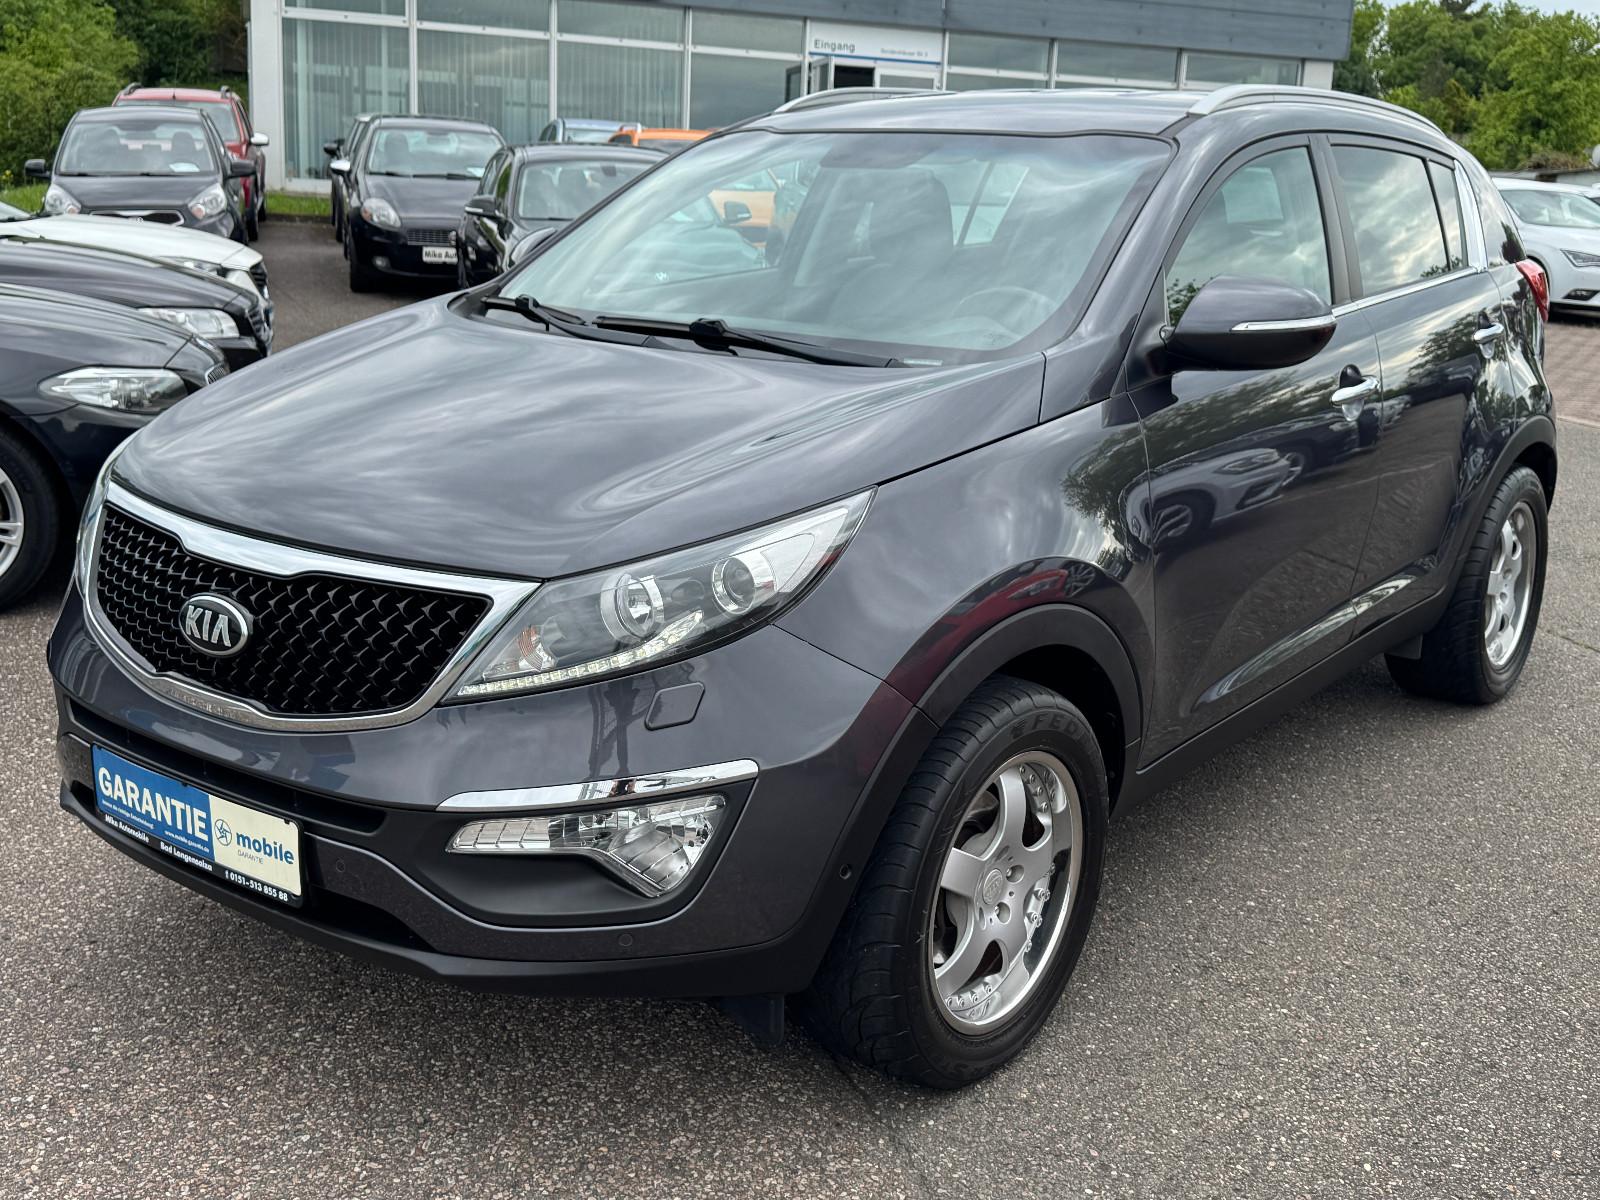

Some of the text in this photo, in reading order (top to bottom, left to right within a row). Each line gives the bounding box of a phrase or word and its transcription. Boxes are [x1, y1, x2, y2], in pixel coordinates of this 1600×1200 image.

[814, 39, 856, 53] Eingang
[186, 605, 231, 648] KIA
[98, 766, 209, 842] GARANTIE
[118, 821, 150, 843] Automobile
[160, 841, 173, 854] Bad
[173, 846, 213, 872] Langensalza
[230, 871, 263, 892] 0151-513
[263, 885, 278, 898] 855
[278, 890, 289, 902] 88
[235, 832, 295, 865] mobile
[237, 849, 264, 865] GARANTIE
